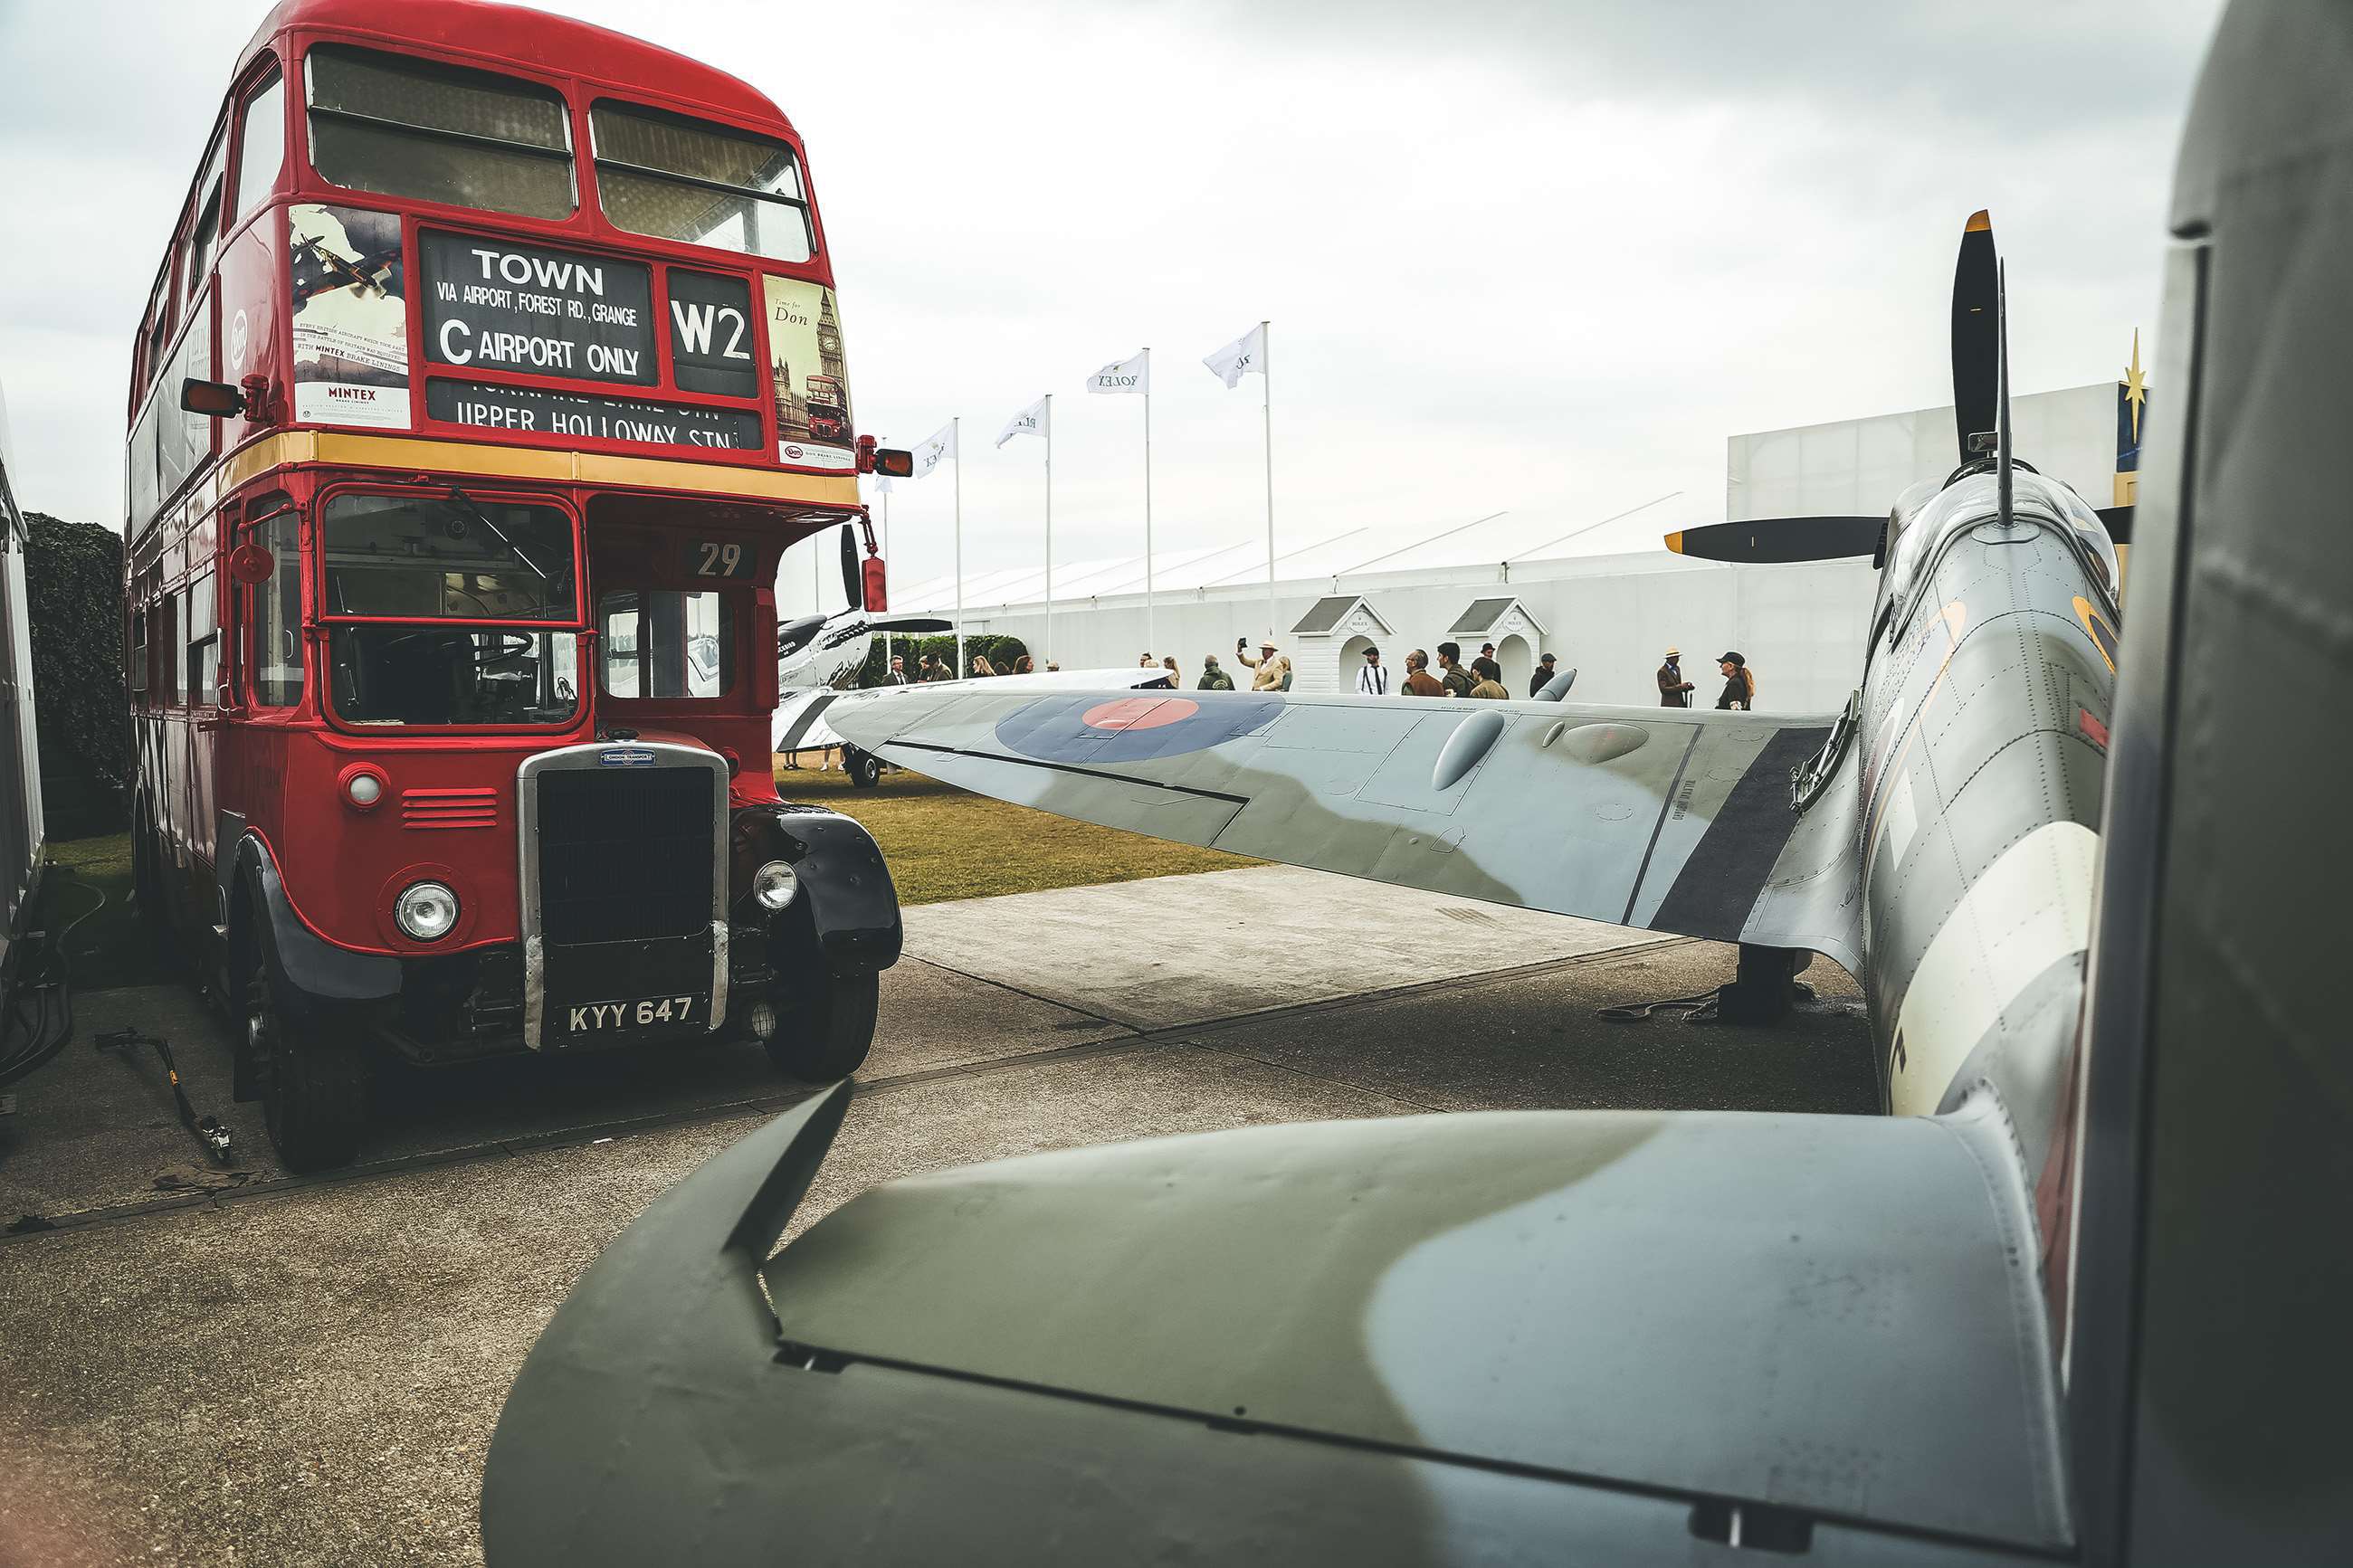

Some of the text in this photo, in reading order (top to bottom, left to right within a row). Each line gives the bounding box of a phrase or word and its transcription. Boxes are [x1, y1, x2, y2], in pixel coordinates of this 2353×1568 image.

[471, 249, 604, 296] TOWN
[436, 281, 458, 302] VIA
[591, 303, 638, 328] GRANGE
[775, 307, 808, 326] Don
[439, 318, 640, 377] C AIRPORT ONLY
[670, 299, 750, 360] W2
[315, 345, 345, 357] MINTEX
[347, 353, 371, 364] BRAKE
[372, 359, 401, 372] LININGS
[328, 386, 376, 401] MINTEX
[457, 401, 535, 432] UPPER
[551, 411, 677, 444] HOLLOWAY
[697, 542, 742, 577] 29
[569, 996, 693, 1031] KYY 647
